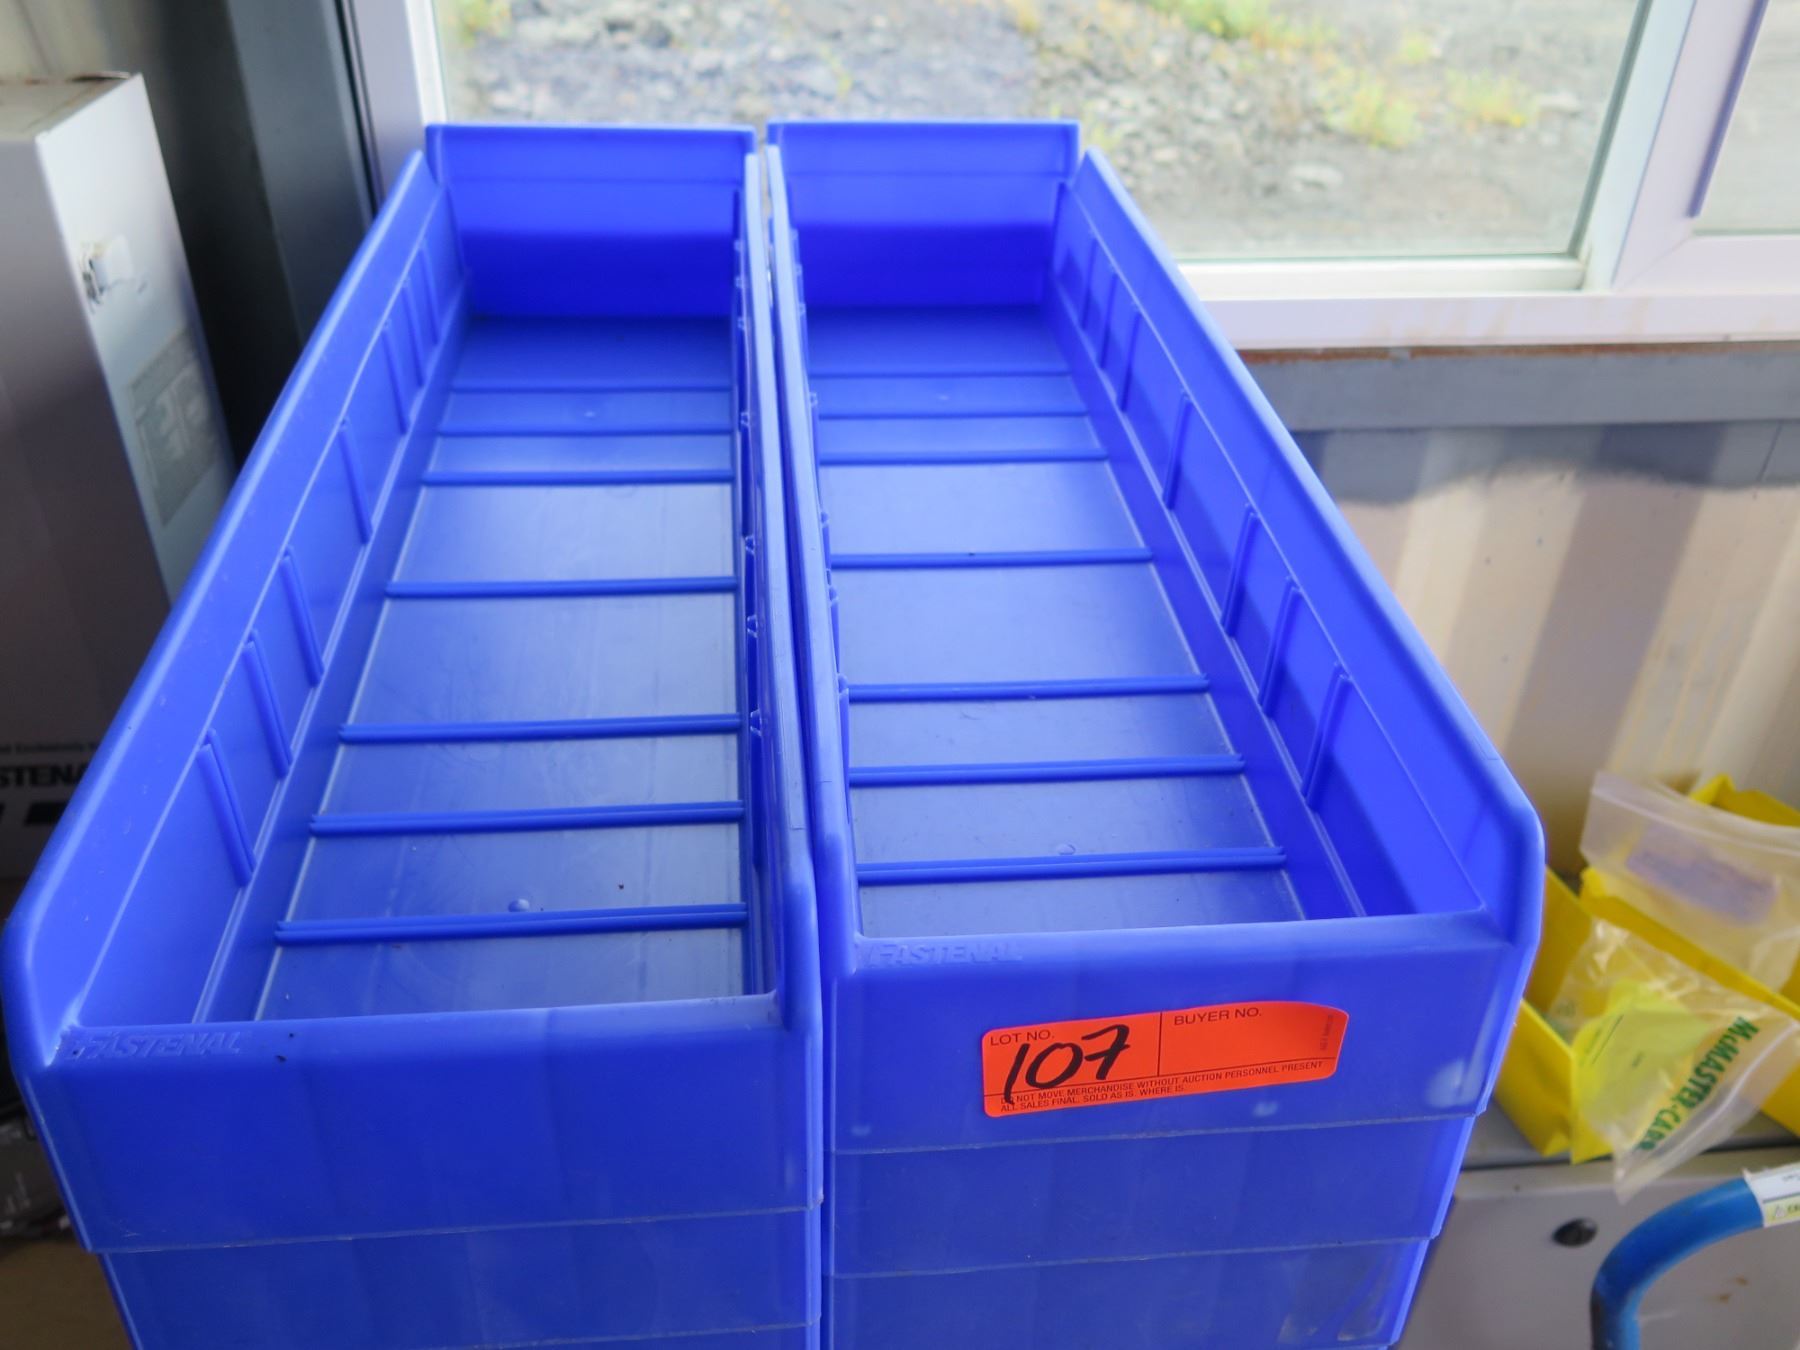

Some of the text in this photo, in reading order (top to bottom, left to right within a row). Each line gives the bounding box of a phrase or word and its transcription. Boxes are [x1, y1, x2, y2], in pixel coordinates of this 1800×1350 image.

[1174, 1007, 1262, 1026] BUYER NO.
[990, 1029, 1055, 1046] LOT NO.
[1004, 1024, 1130, 1105] 107
[1016, 1093, 1035, 1103] NOT
[1038, 1090, 1064, 1101] MOVE
[1067, 1082, 1134, 1097] MERCHANDISE
[1137, 1077, 1180, 1091] WITHOUT
[1183, 1073, 1222, 1085] AUCTION
[1225, 1066, 1279, 1080] PERSONNEL
[1281, 1060, 1324, 1072] PRESENT
[1001, 1103, 1018, 1112] ALL
[1020, 1100, 1049, 1111] SALES
[1083, 1093, 1108, 1103] SOLD
[1110, 1090, 1122, 1100] AS
[1139, 1084, 1171, 1096] WHERE
